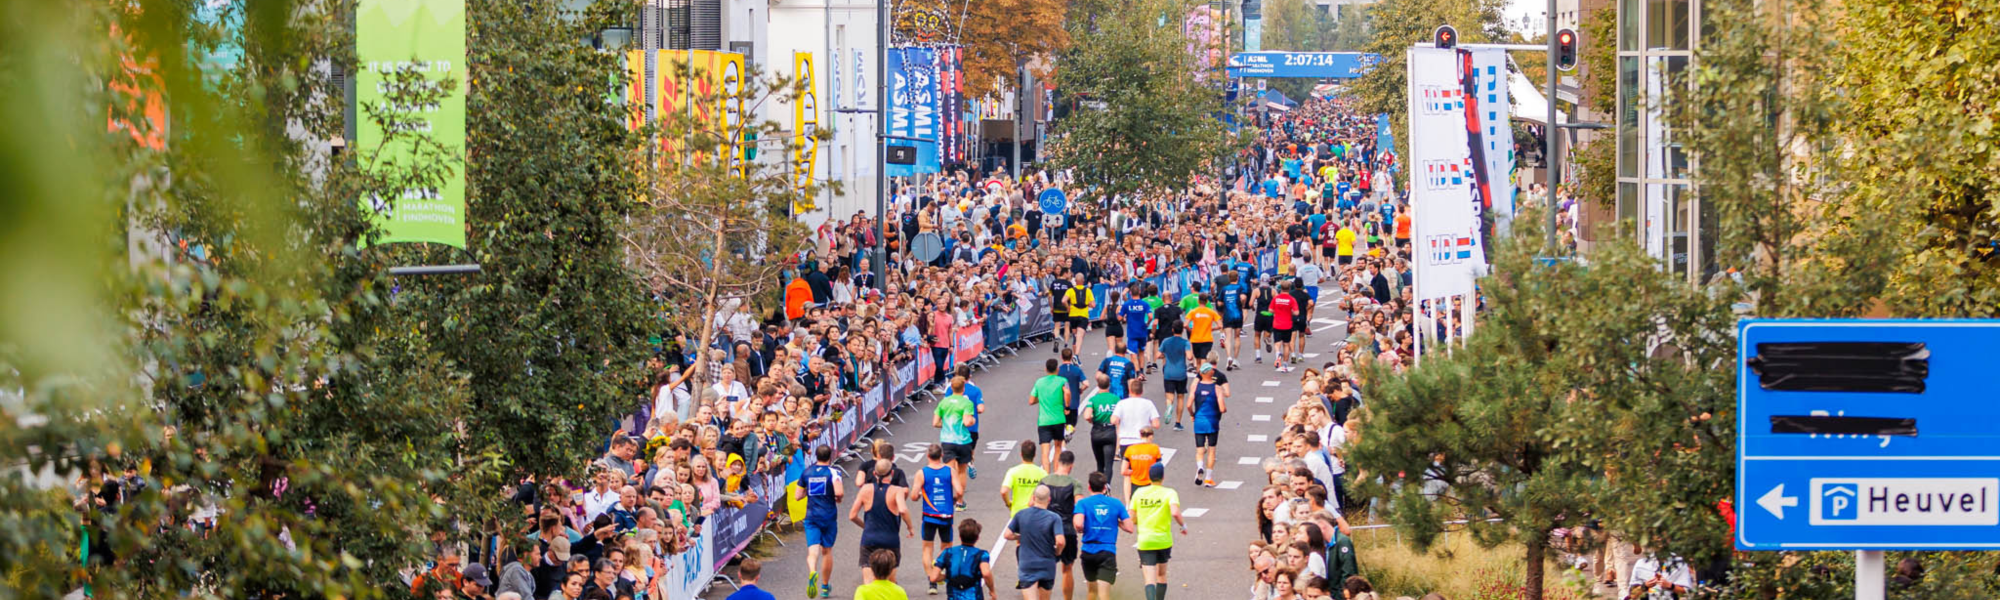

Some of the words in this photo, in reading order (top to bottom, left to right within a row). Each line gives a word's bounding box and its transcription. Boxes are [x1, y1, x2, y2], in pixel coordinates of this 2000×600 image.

[368, 61, 379, 73] IT
[382, 61, 393, 73] IS
[436, 60, 451, 73] TO
[1284, 54, 1333, 66] 2:07:14
[892, 72, 908, 144] ASML
[914, 71, 932, 138] ASML
[403, 203, 455, 215] MARATHON
[403, 212, 456, 225] EINDHOVEN
[1426, 234, 1470, 266] VDL
[1018, 477, 1039, 485] TEAM
[1140, 498, 1162, 507] TEAM
[1868, 486, 1987, 513] Heuvel
